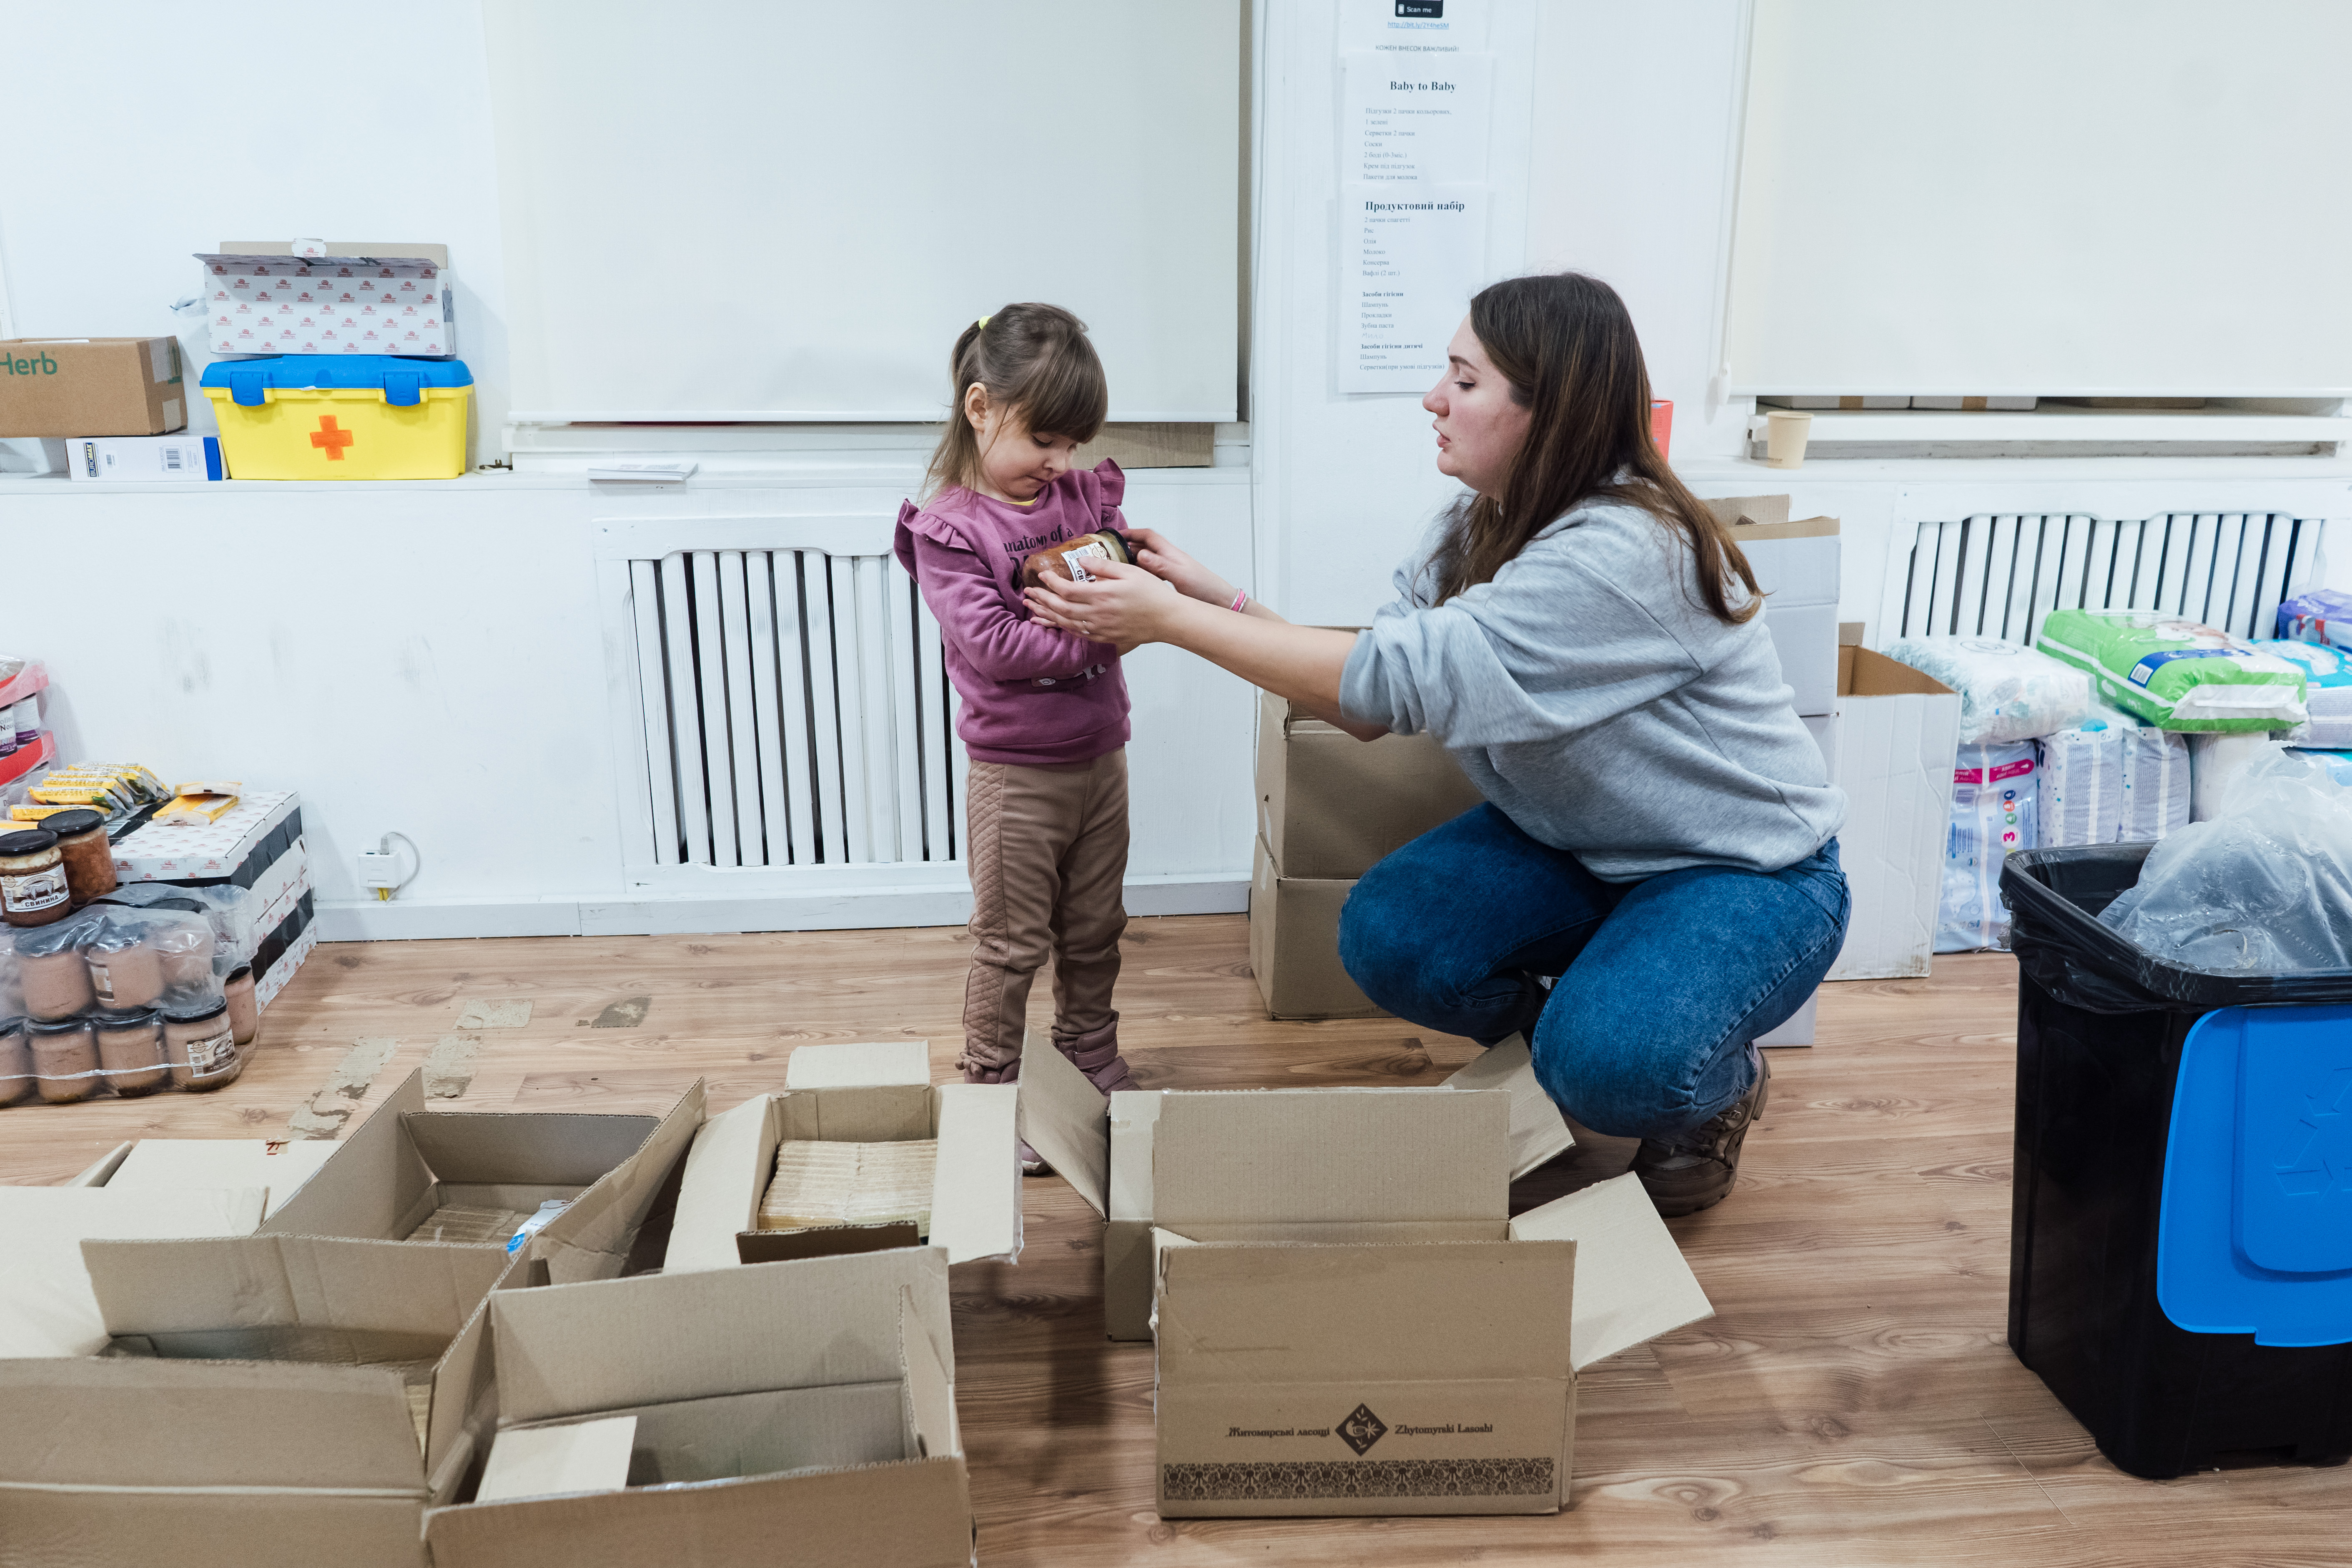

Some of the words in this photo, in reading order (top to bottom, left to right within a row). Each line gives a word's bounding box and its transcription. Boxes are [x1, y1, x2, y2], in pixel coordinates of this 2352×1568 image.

[1390, 81, 1415, 93] Baby
[1419, 82, 1427, 90] to
[1432, 82, 1456, 93] Baby
[1366, 201, 1434, 212] Продуктовий
[1437, 201, 1464, 212] набір
[86, 444, 96, 476] BUROMAX
[1051, 524, 1063, 542] of
[1066, 528, 1074, 537] a
[1076, 569, 1086, 582] СВ
[2003, 832, 2015, 842] 3
[25, 895, 59, 907] СВИНИНА
[1228, 1427, 1294, 1438] Житомирські
[1395, 1424, 1455, 1436] Zhytomyrski
